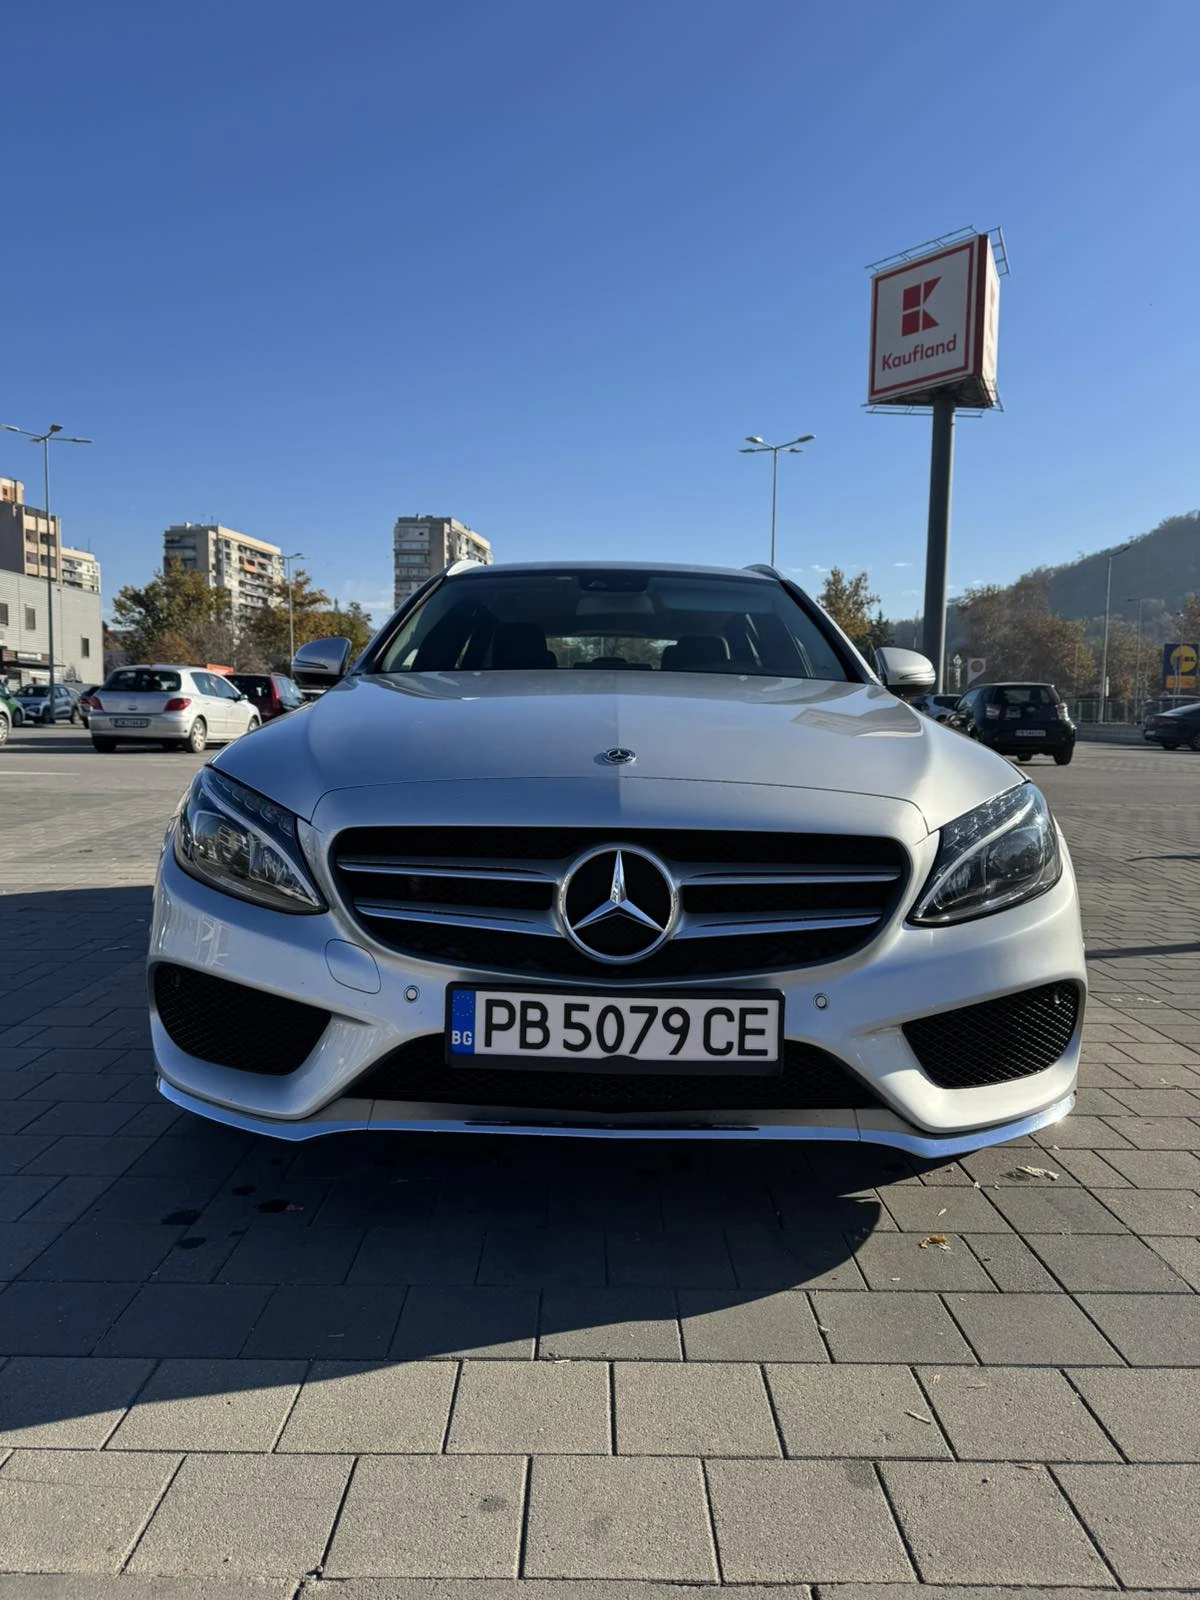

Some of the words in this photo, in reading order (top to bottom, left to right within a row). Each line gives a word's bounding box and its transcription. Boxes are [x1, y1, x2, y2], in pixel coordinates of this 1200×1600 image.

[882, 334, 957, 371] Kaufland
[451, 1030, 473, 1045] BG
[484, 999, 550, 1049] PB
[562, 1003, 691, 1056] 5079
[703, 1006, 768, 1056] CE
